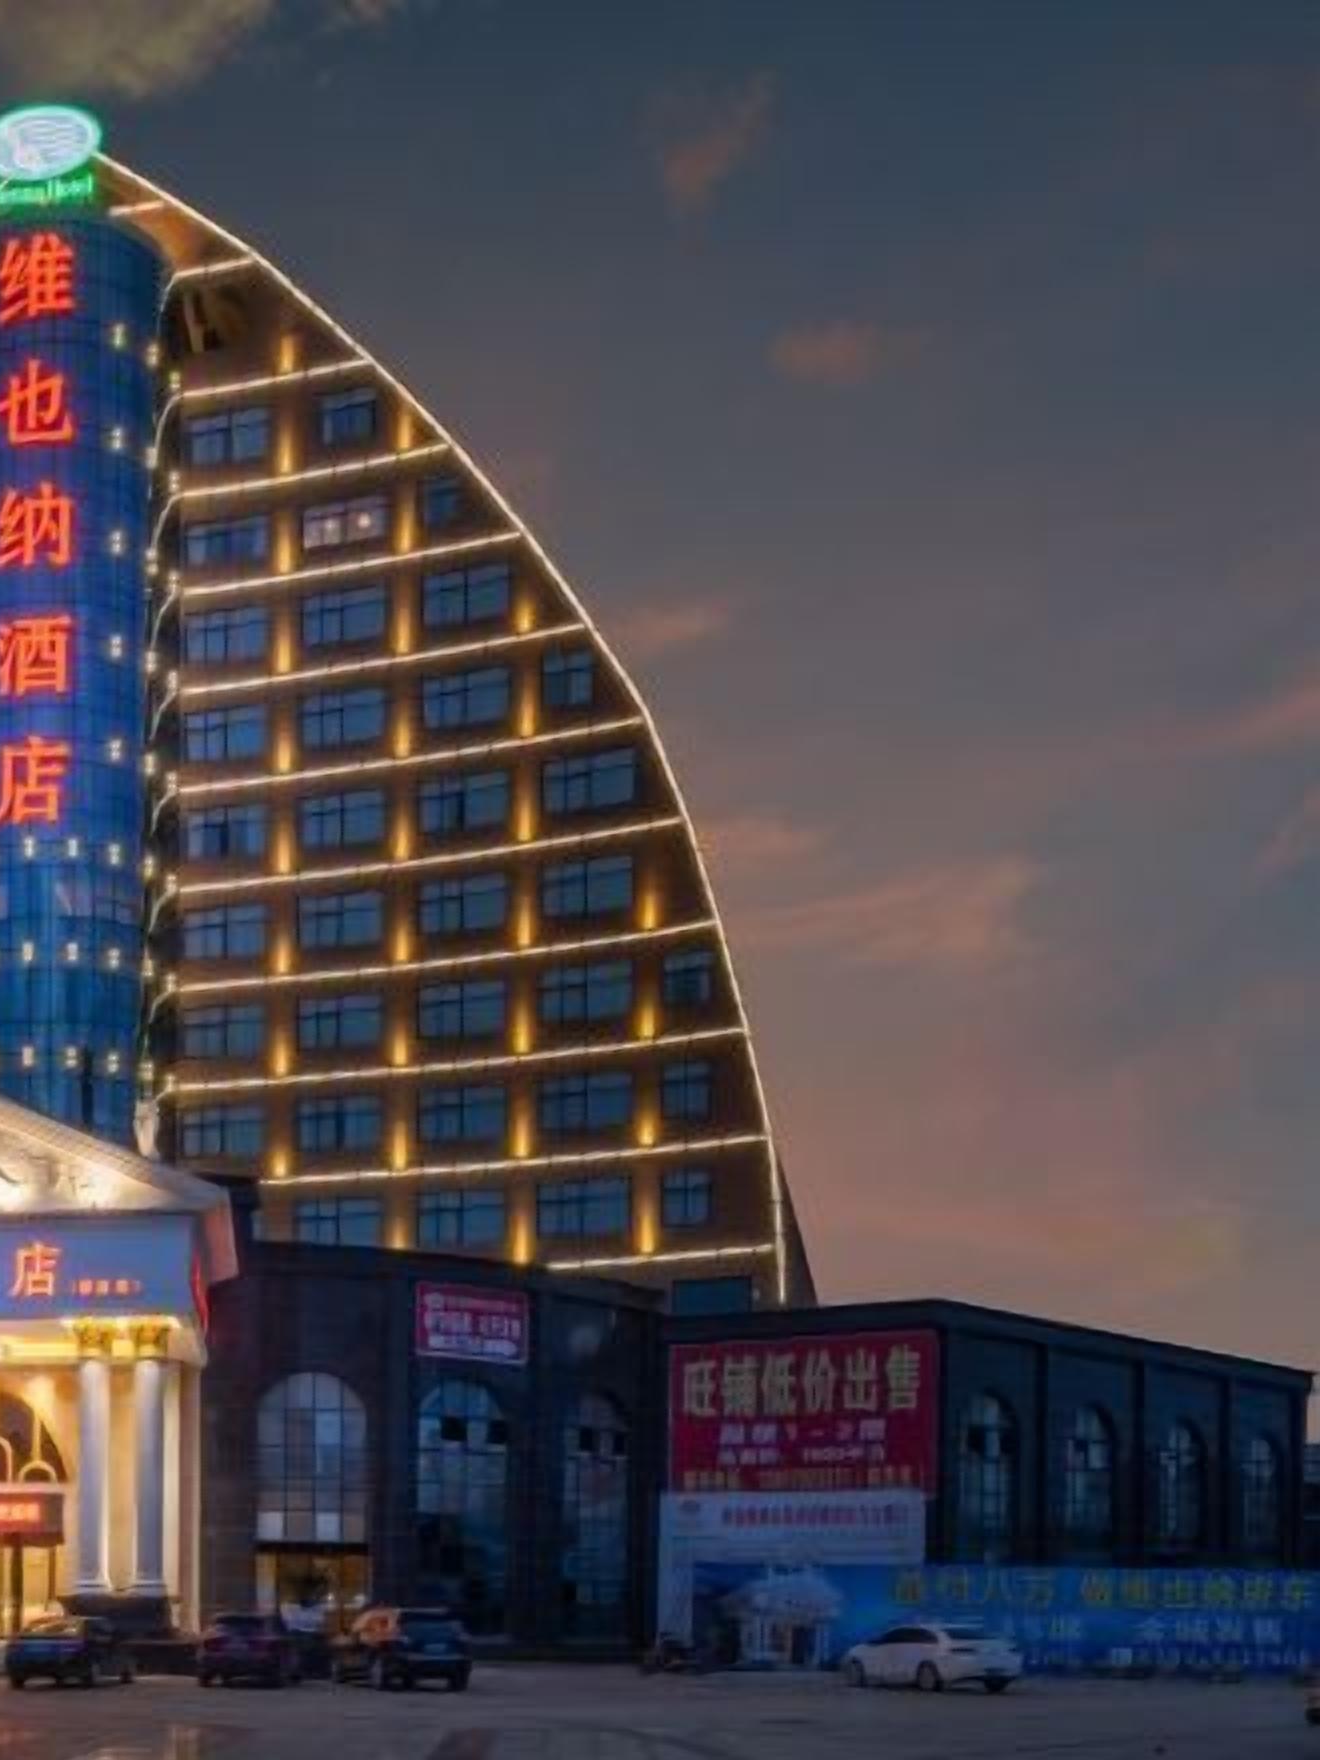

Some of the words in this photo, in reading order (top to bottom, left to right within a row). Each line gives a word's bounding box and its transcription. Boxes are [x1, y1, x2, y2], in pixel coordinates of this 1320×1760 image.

[682, 1344, 922, 1417] 旺铺低价出售
